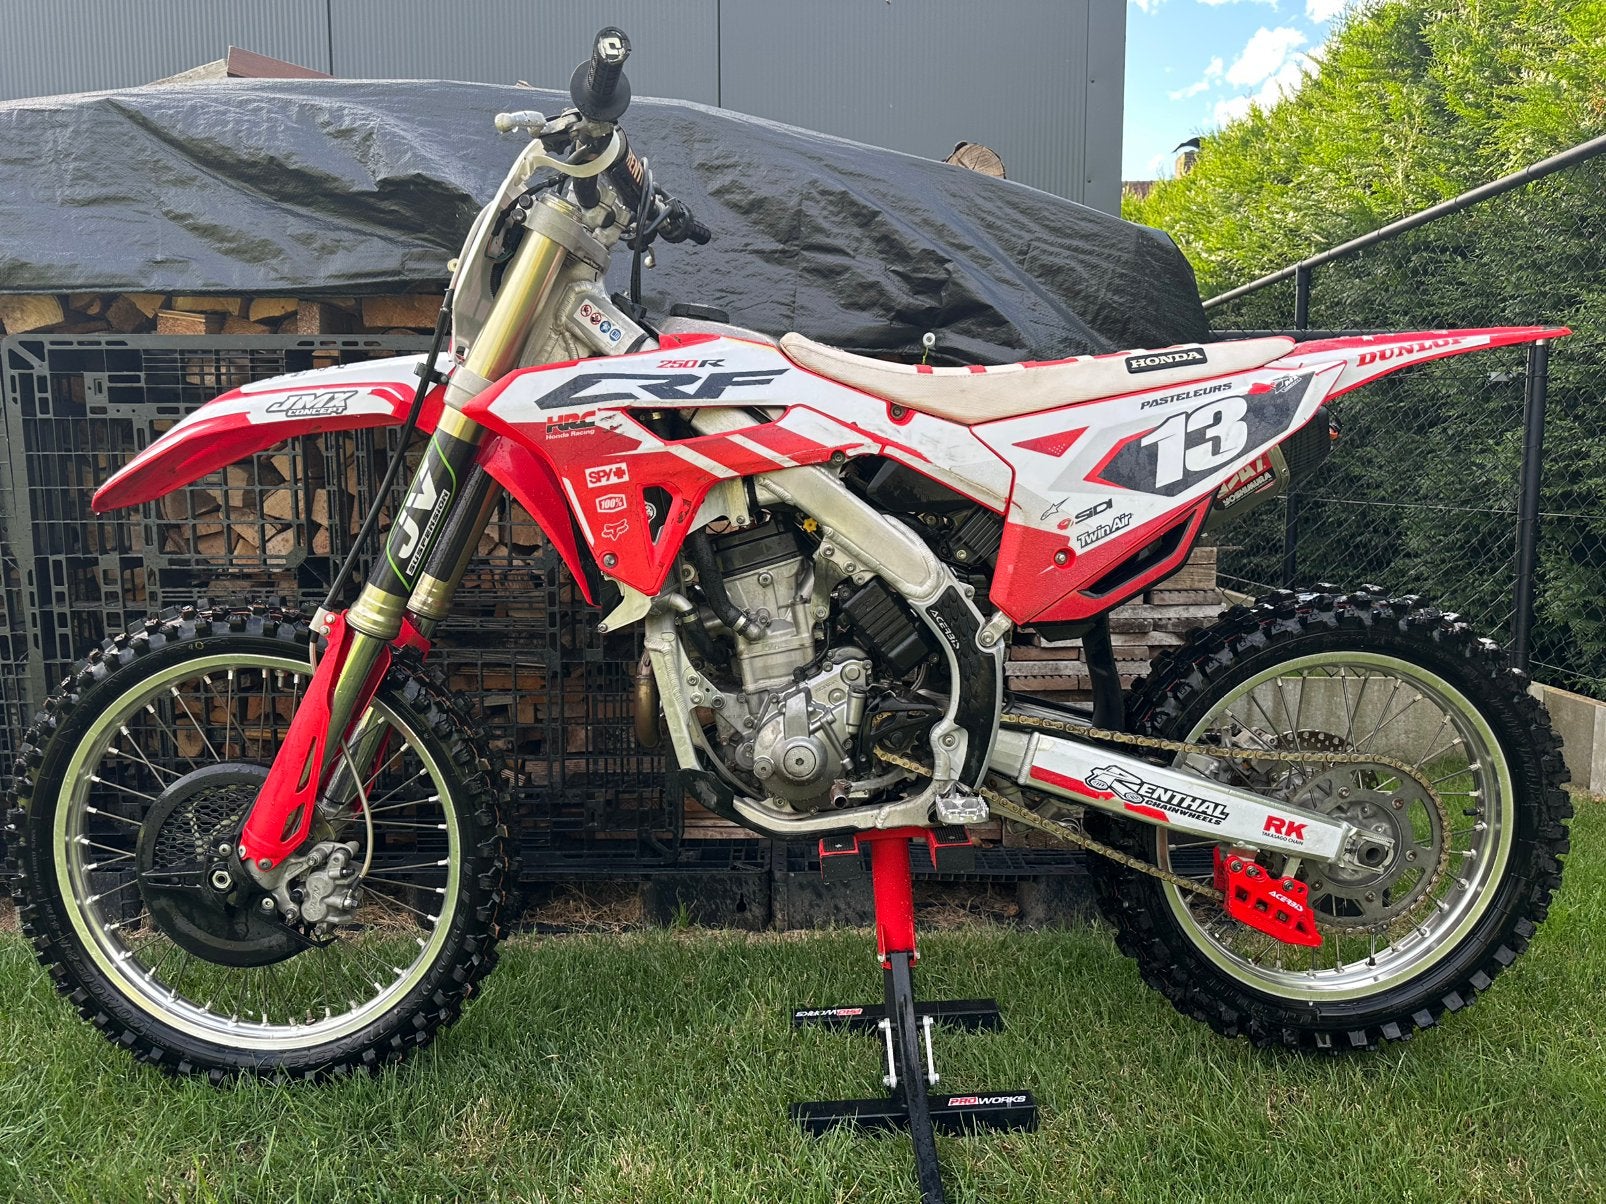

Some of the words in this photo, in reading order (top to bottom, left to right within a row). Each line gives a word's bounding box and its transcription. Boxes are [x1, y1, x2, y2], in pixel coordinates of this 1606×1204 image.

[1129, 351, 1203, 369] HONDA
[1357, 336, 1470, 367] DUNLOP
[265, 389, 358, 413] JMX
[535, 368, 790, 410] CRF
[1140, 382, 1232, 410] PASTELEURS
[286, 406, 347, 417] CONCEPT
[546, 410, 596, 433] HRC
[570, 429, 596, 437] Racing
[1140, 395, 1248, 489] 13
[600, 497, 623, 510] 100%
[408, 491, 449, 575] SUSPENSION
[1085, 765, 1230, 819] RENTHAL
[1144, 799, 1223, 826] CHAINWHEELS
[1263, 815, 1308, 841] RK
[948, 1094, 1026, 1107] PROWORKS
